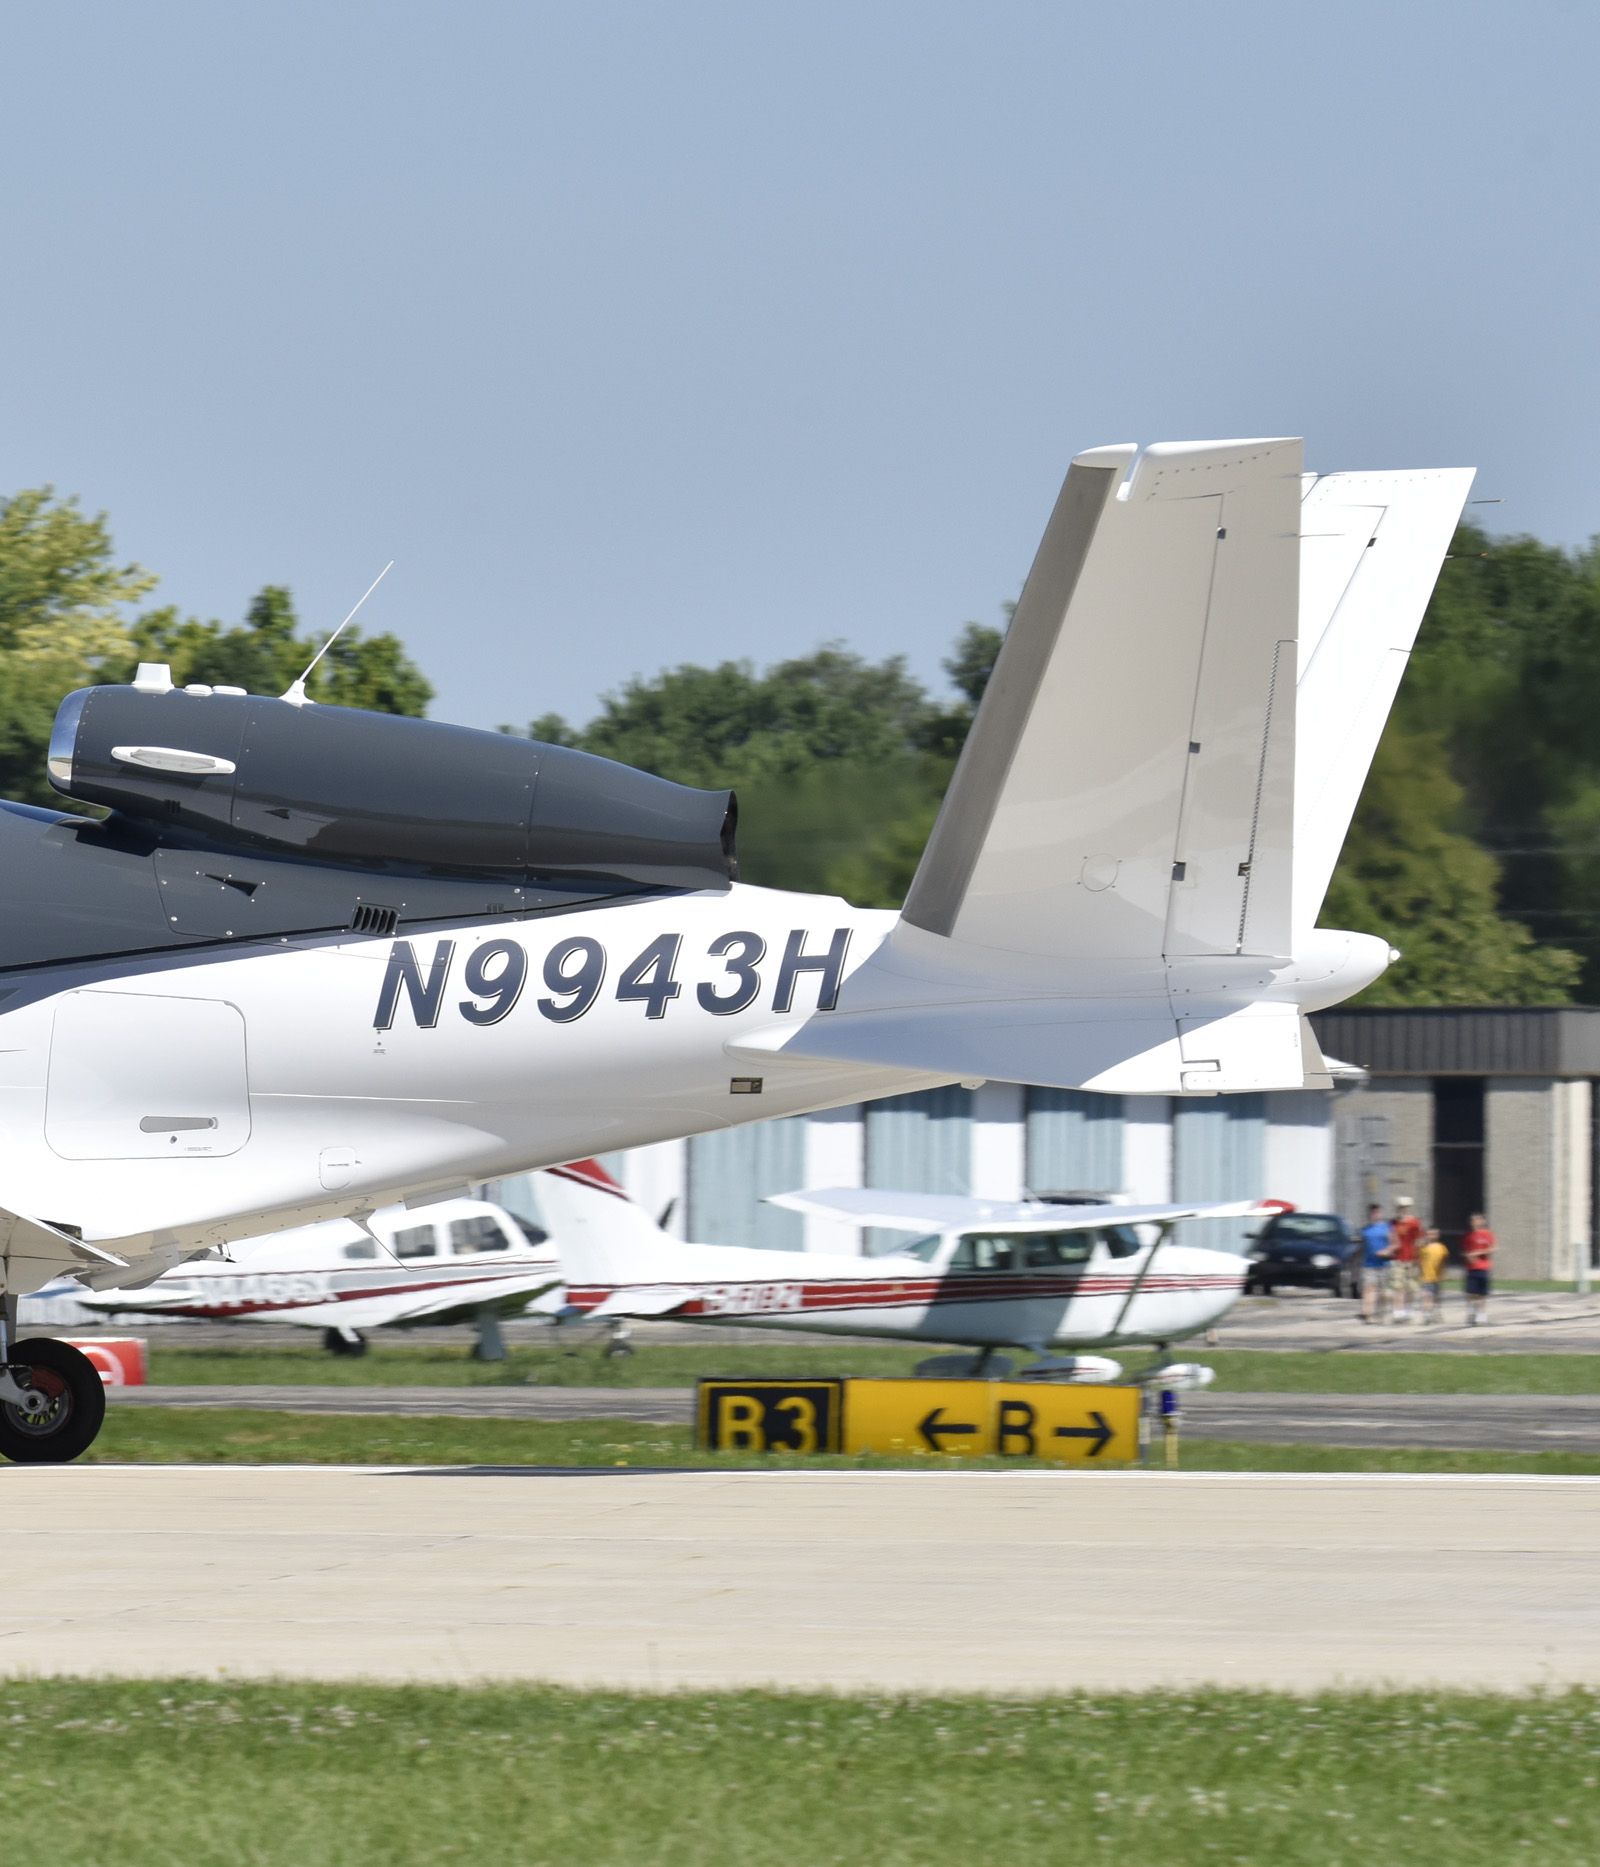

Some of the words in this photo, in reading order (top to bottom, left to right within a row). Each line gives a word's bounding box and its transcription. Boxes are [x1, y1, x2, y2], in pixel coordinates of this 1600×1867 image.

[373, 928, 854, 1030] N9943H
[718, 1395, 817, 1453] B3
[999, 1400, 1037, 1456] B
